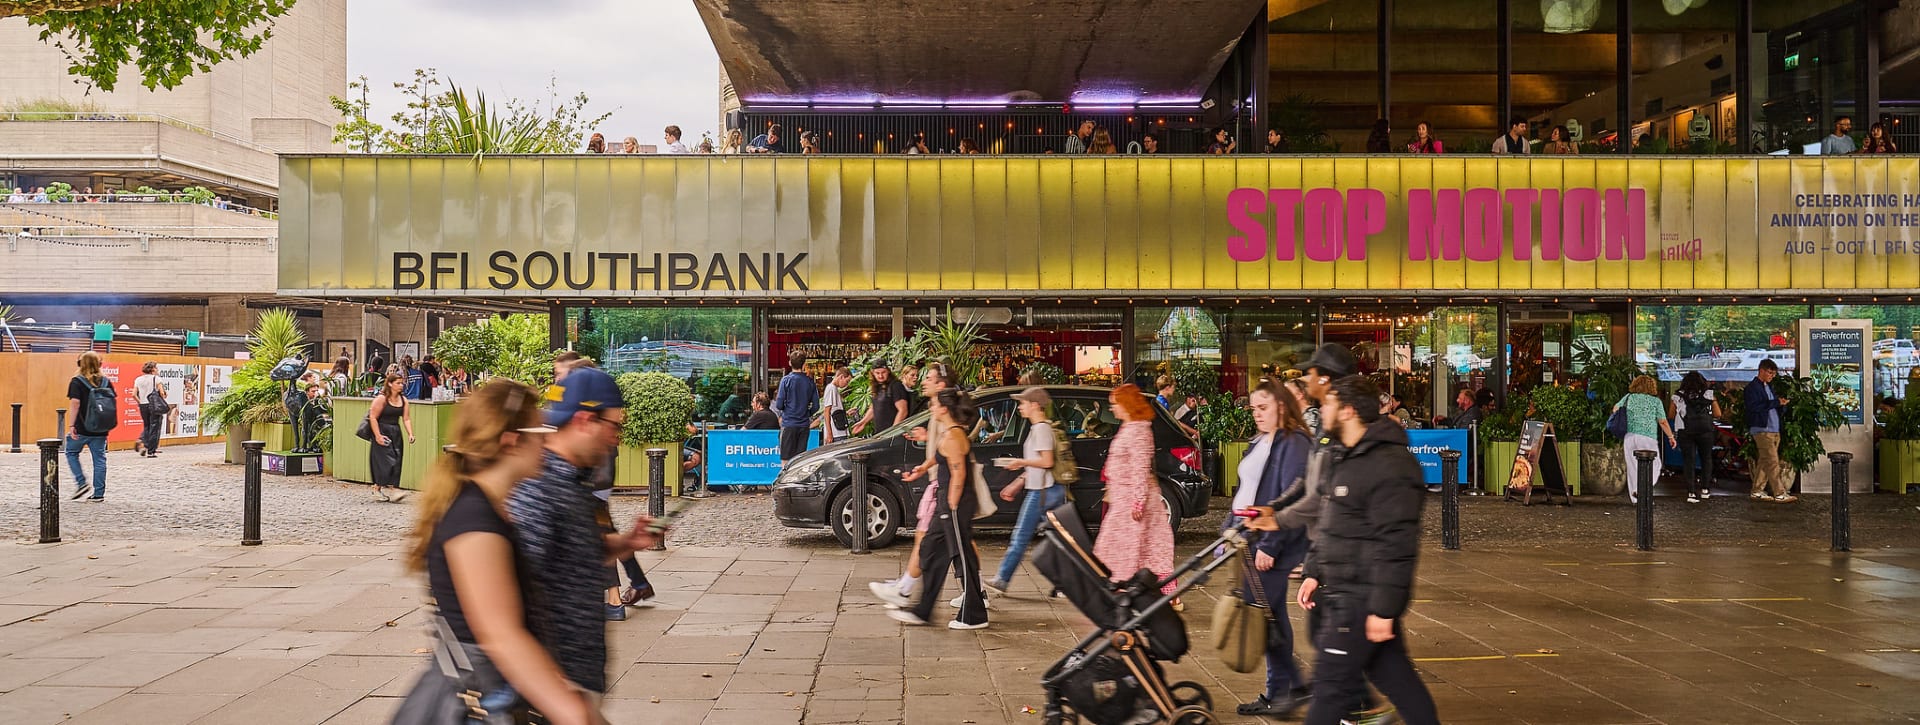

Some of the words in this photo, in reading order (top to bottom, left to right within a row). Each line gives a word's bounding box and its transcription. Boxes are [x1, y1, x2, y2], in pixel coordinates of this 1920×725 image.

[1795, 194, 1898, 207] CELEBRATING
[1227, 187, 1386, 262] STOP
[1408, 187, 1646, 262] MOTION
[1770, 213, 1858, 227] ANIMATION
[1864, 213, 1885, 227] ON
[1891, 213, 1919, 227] THE
[1784, 241, 1815, 254] AUG
[1836, 241, 1864, 254] OCT
[1885, 241, 1906, 254] BFI
[393, 251, 468, 290] BFI
[488, 250, 809, 291] SOUTHBANK
[159, 368, 184, 378] ondon's
[180, 411, 197, 421] Street
[182, 423, 197, 433] Food
[725, 445, 744, 455] BFI
[746, 445, 780, 455] Riverf
[1406, 444, 1449, 454] verfront
